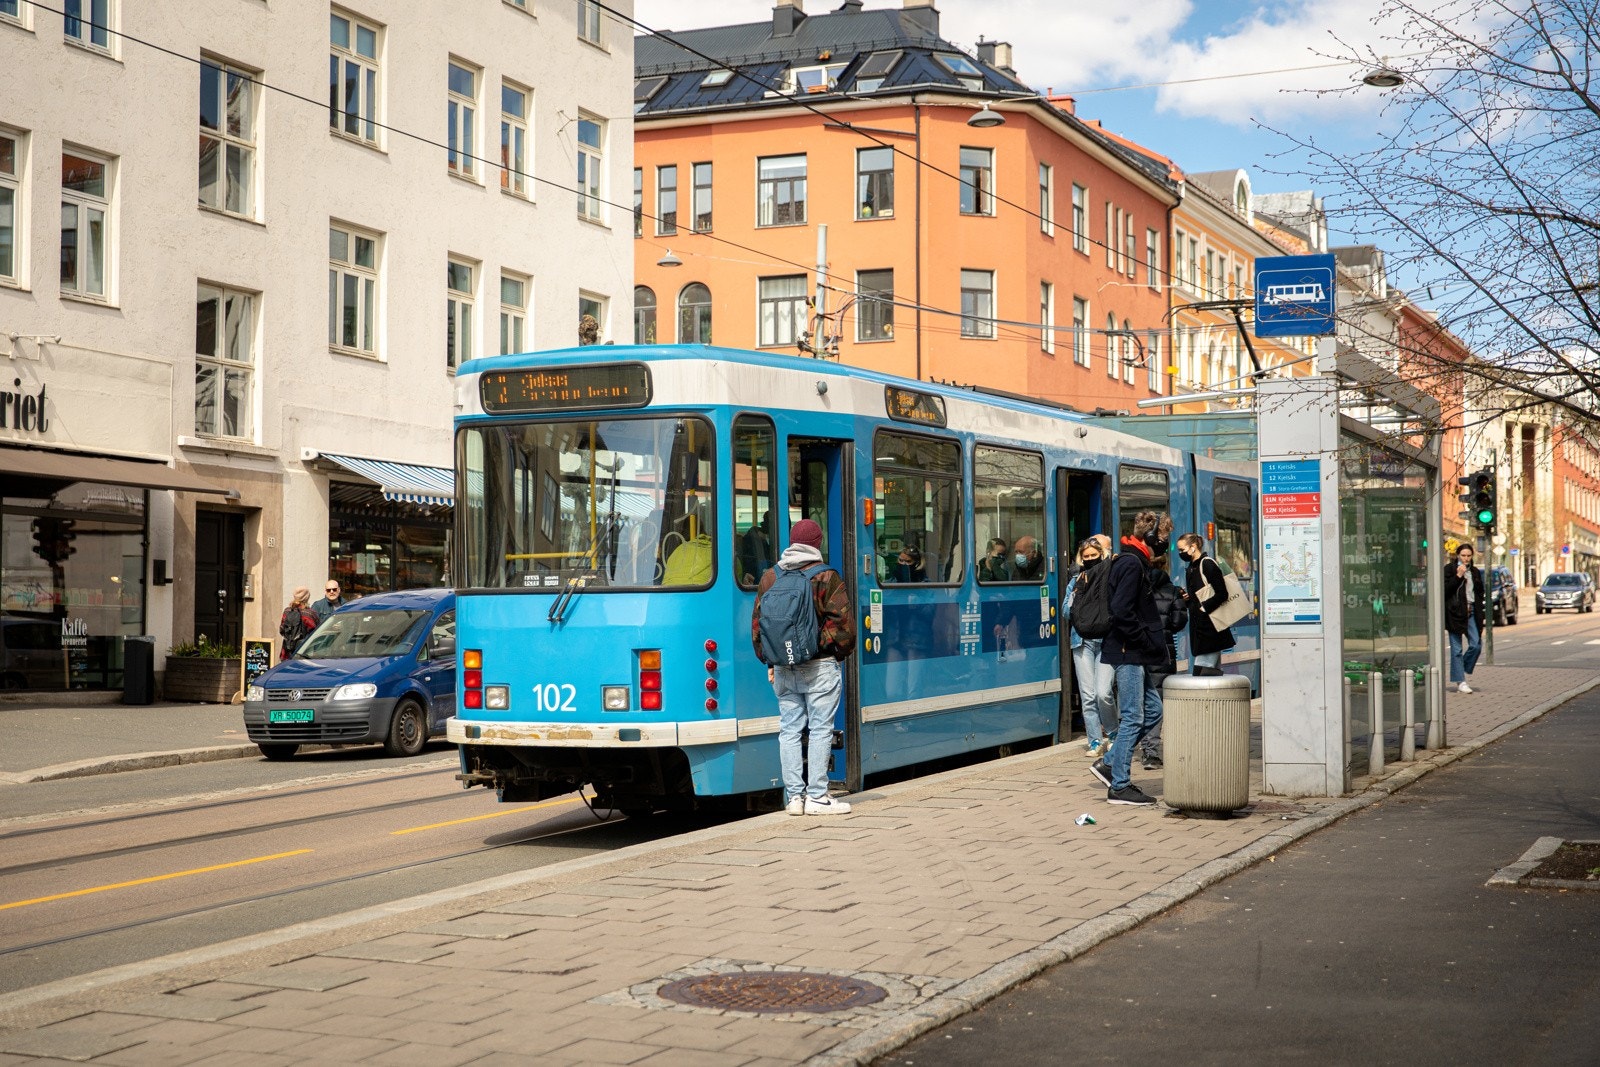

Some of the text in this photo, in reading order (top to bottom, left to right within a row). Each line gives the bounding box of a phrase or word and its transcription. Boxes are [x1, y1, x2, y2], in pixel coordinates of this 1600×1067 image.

[1277, 463, 1296, 471] Kjelsås
[1277, 474, 1297, 482] Kjelsås
[1278, 495, 1297, 503] Kjelsås
[1278, 506, 1297, 514] Kjelsås
[1349, 569, 1384, 585] helt
[61, 617, 88, 636] Kaffe
[532, 683, 577, 712] 102
[273, 711, 312, 721] XR 50074
